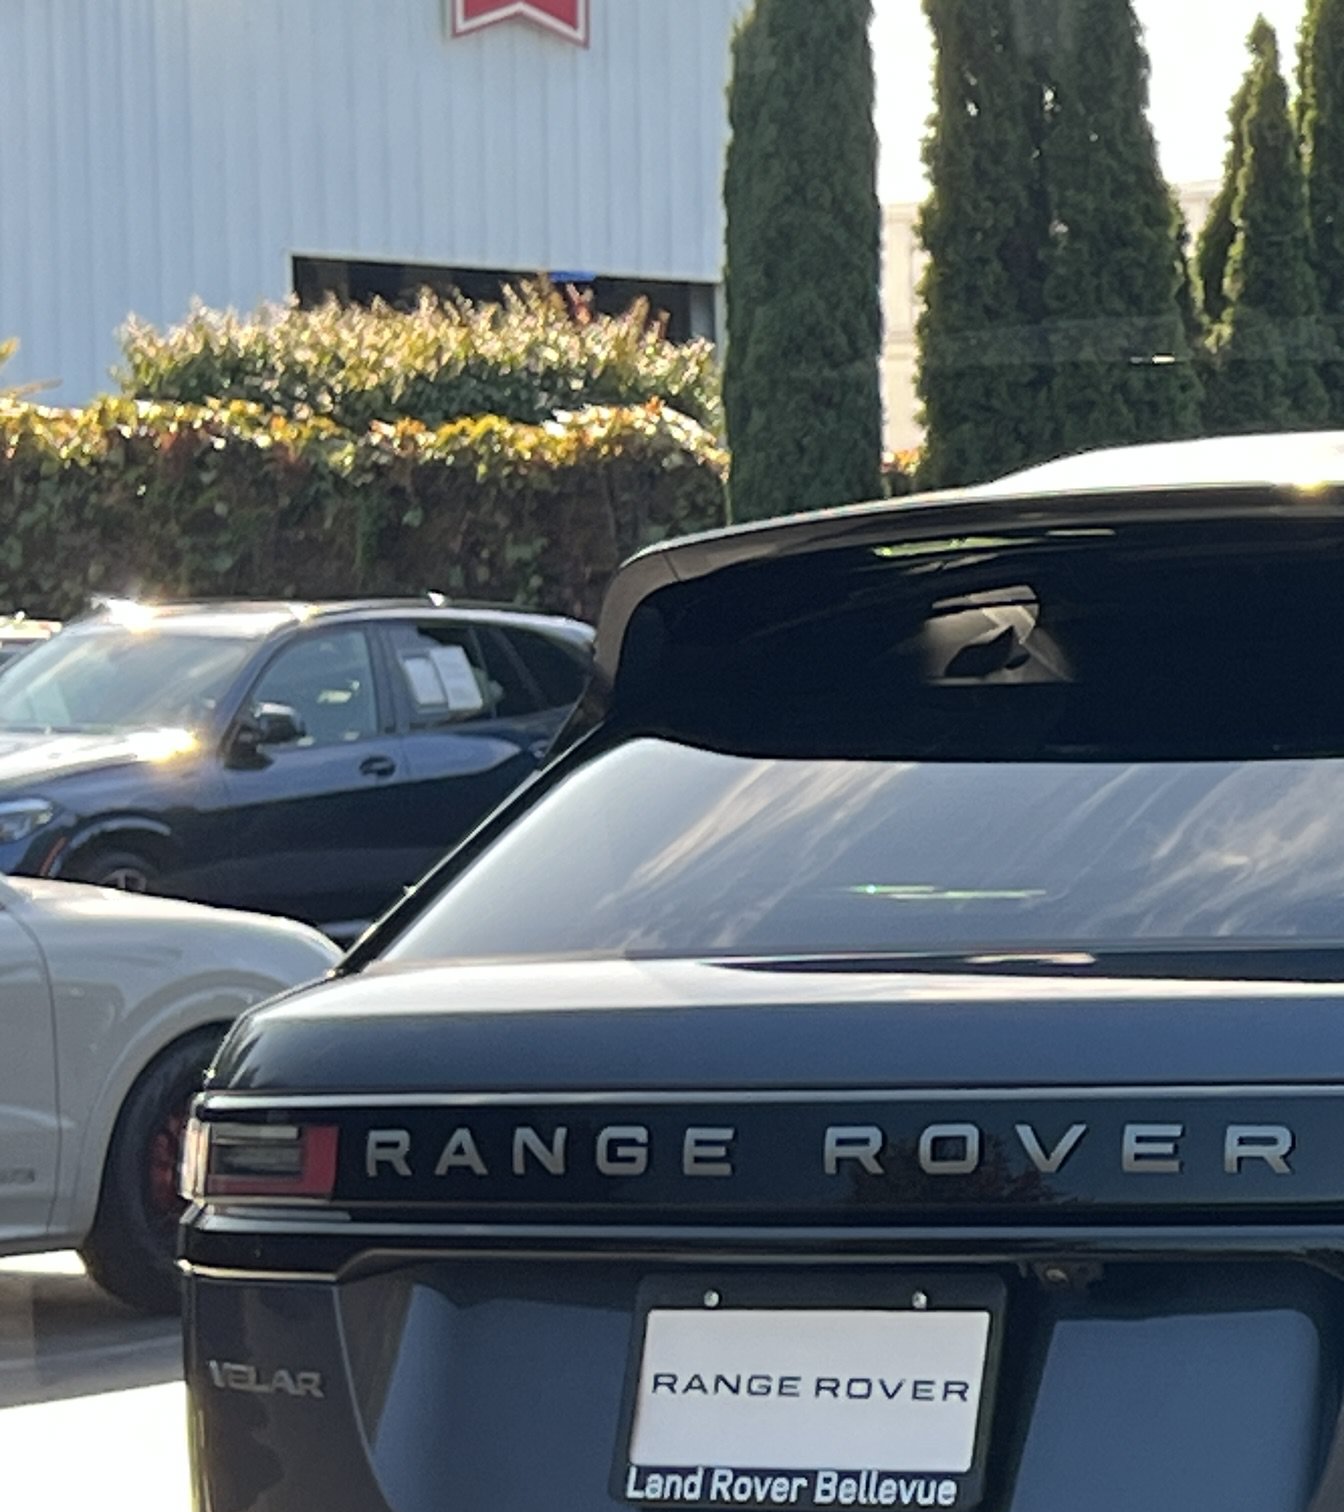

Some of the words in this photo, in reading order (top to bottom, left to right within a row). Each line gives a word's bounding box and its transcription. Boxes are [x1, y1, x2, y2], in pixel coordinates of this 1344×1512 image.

[364, 1125, 735, 1177] RANGE
[823, 1122, 1296, 1175] ROVER
[208, 1359, 325, 1399] VELAR
[651, 1372, 802, 1398] RANGE
[814, 1377, 970, 1402] ROVER
[626, 1465, 704, 1501] Land
[709, 1467, 808, 1503] Rover
[813, 1469, 958, 1506] Bellevue
